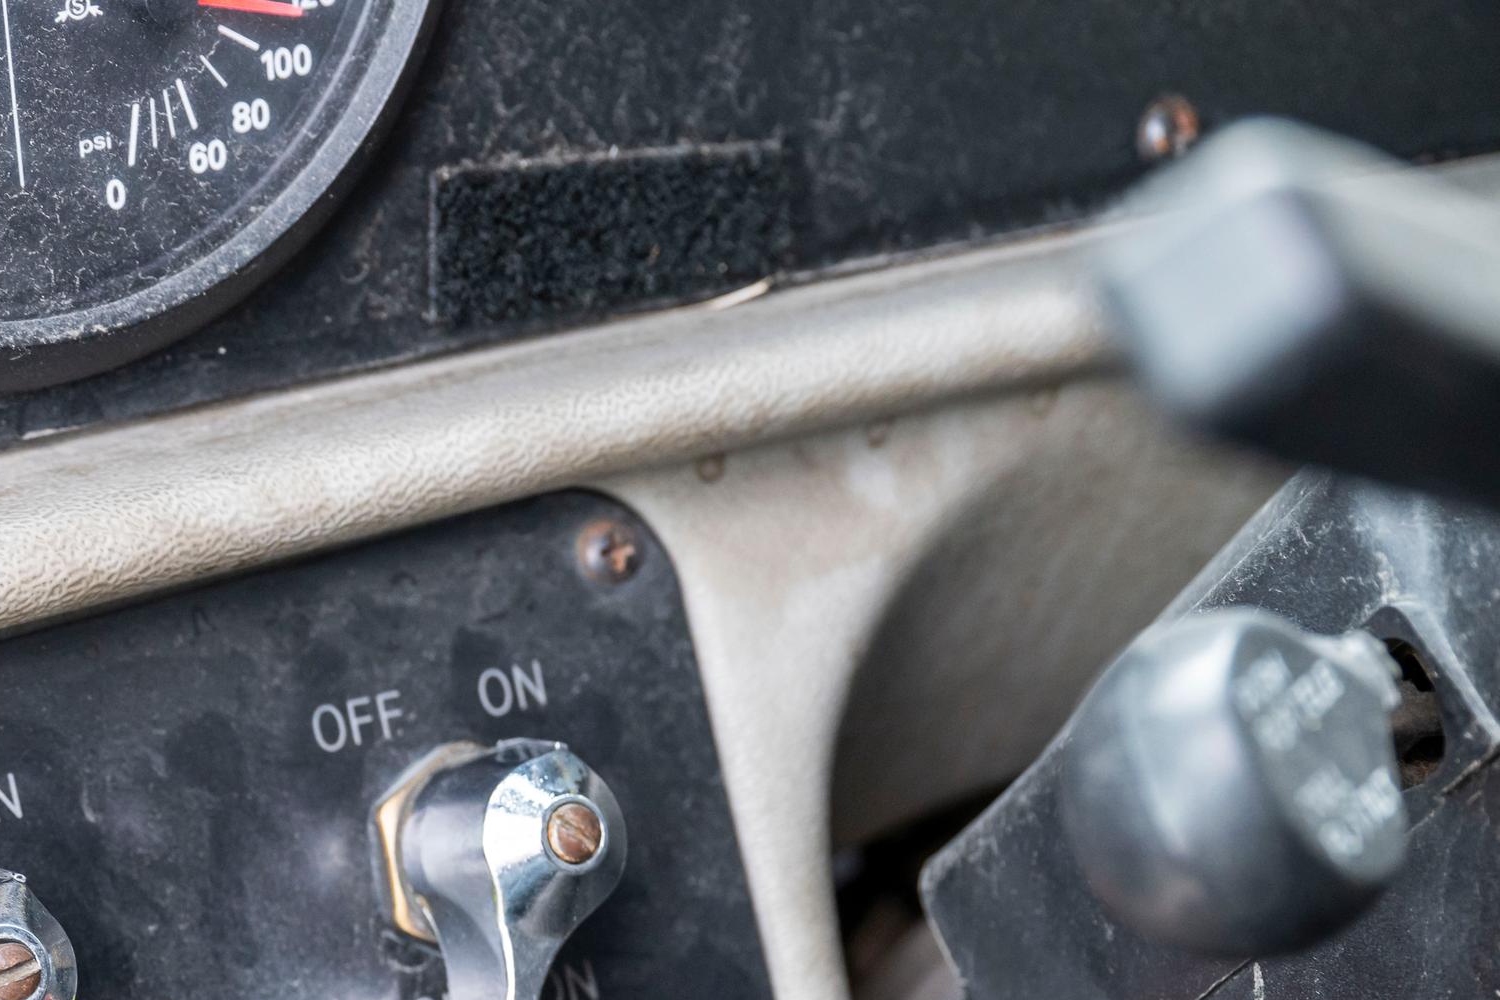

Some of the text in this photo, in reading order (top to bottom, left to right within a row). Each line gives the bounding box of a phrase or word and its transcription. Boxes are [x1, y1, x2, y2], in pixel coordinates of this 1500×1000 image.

[260, 44, 312, 81] 100
[232, 98, 270, 133] 80
[79, 132, 112, 158] psi
[189, 139, 227, 173] 60
[106, 178, 126, 210] 0
[311, 659, 548, 753] OFF ON
